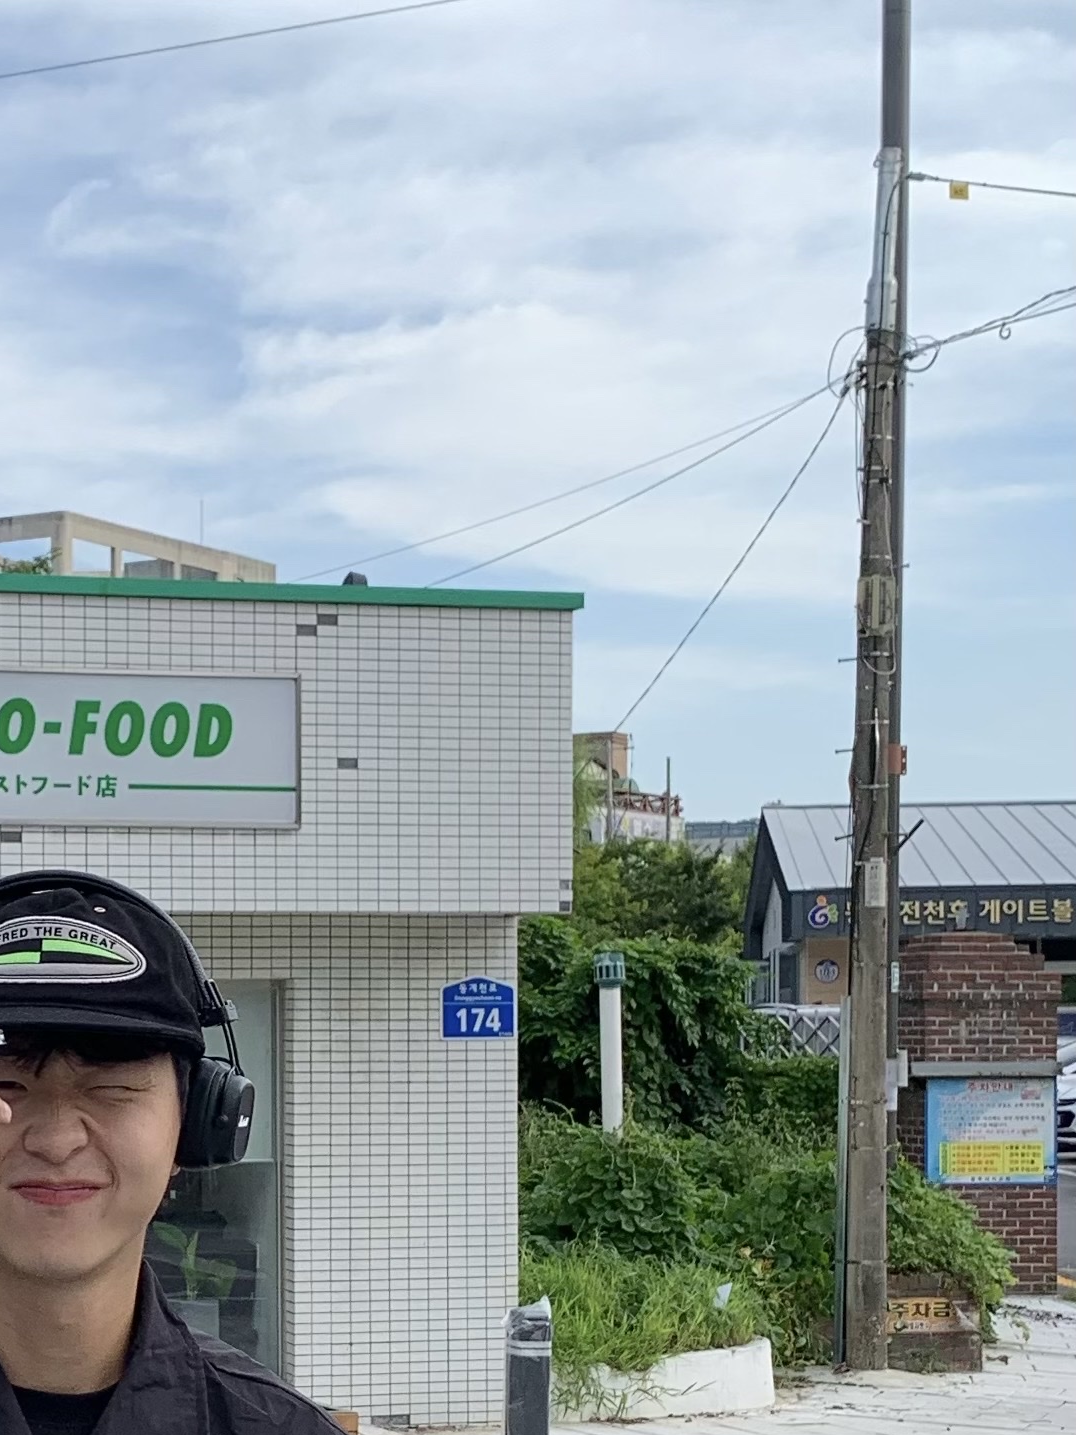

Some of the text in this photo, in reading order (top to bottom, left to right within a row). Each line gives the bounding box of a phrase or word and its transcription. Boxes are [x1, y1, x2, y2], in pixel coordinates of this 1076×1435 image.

[978, 898, 1074, 924] 게이트볼
[34, 926, 63, 937] THE
[68, 929, 117, 950] GREAT
[456, 1007, 501, 1033] 174
